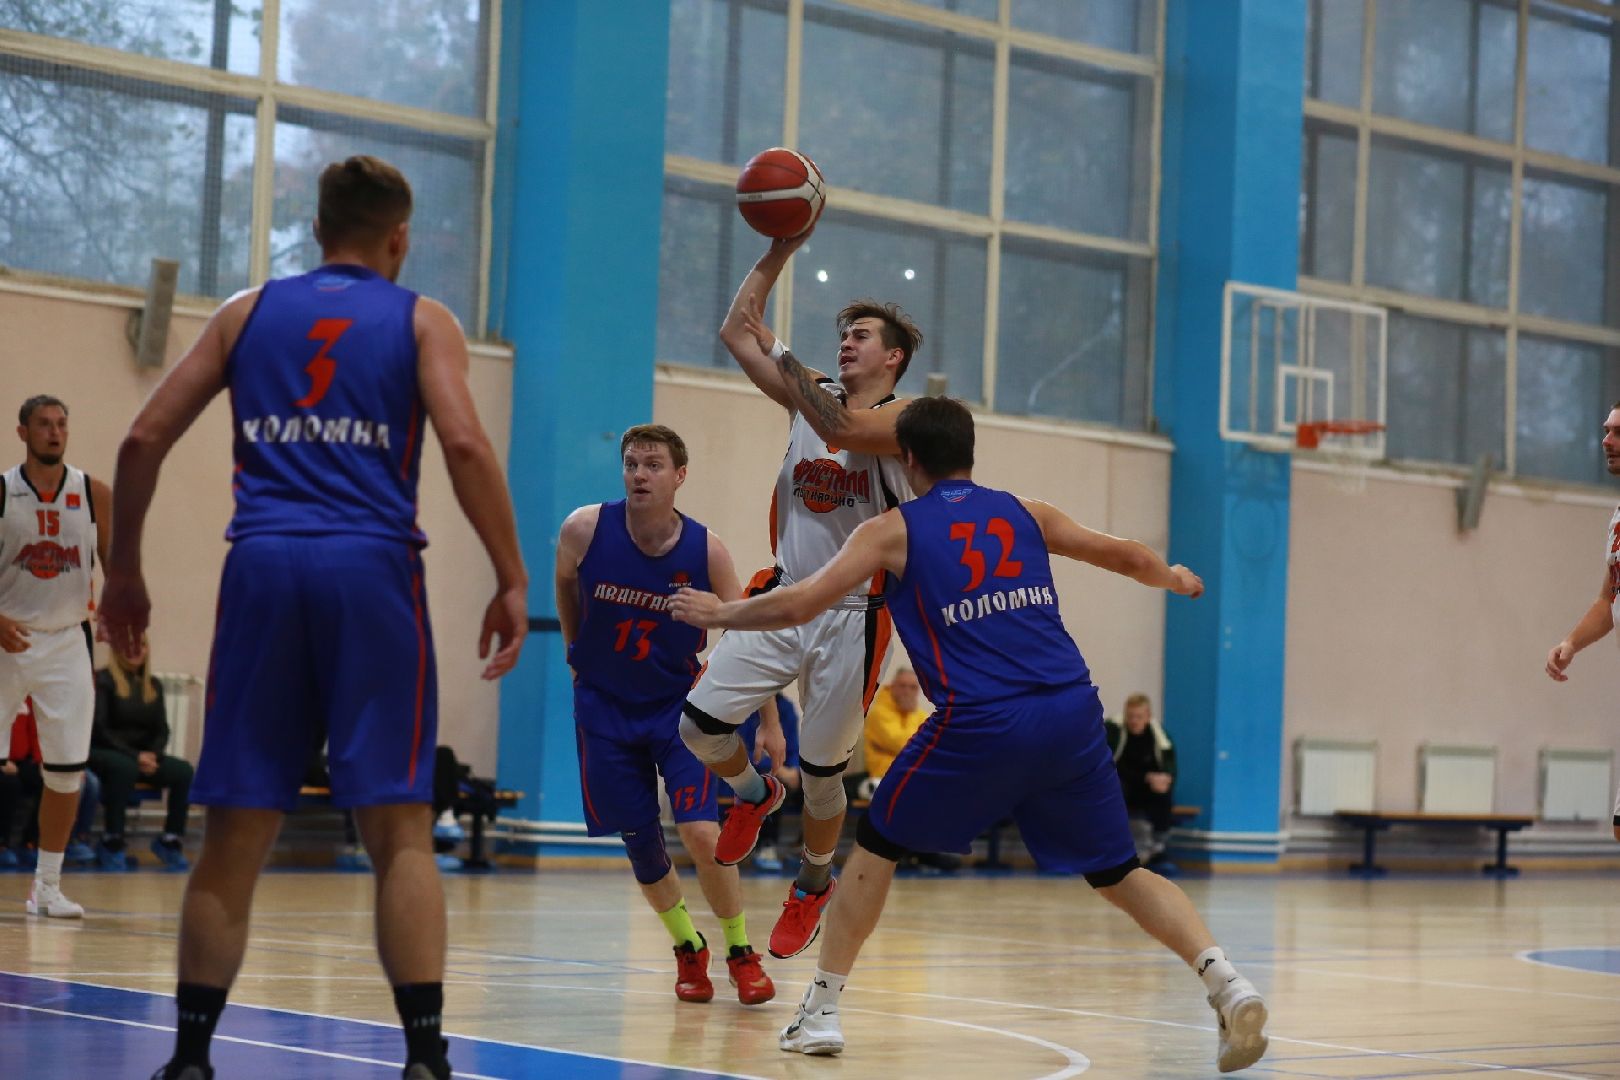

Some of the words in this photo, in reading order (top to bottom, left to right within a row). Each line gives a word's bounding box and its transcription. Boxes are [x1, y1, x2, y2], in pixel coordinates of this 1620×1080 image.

[294, 318, 354, 408] 3
[243, 414, 391, 449] КОЛОМНА
[36, 509, 60, 537] 15
[949, 517, 1024, 592] 32
[941, 586, 1053, 627] КОЛОМНА
[614, 618, 658, 661] 13
[674, 785, 696, 811] 13
